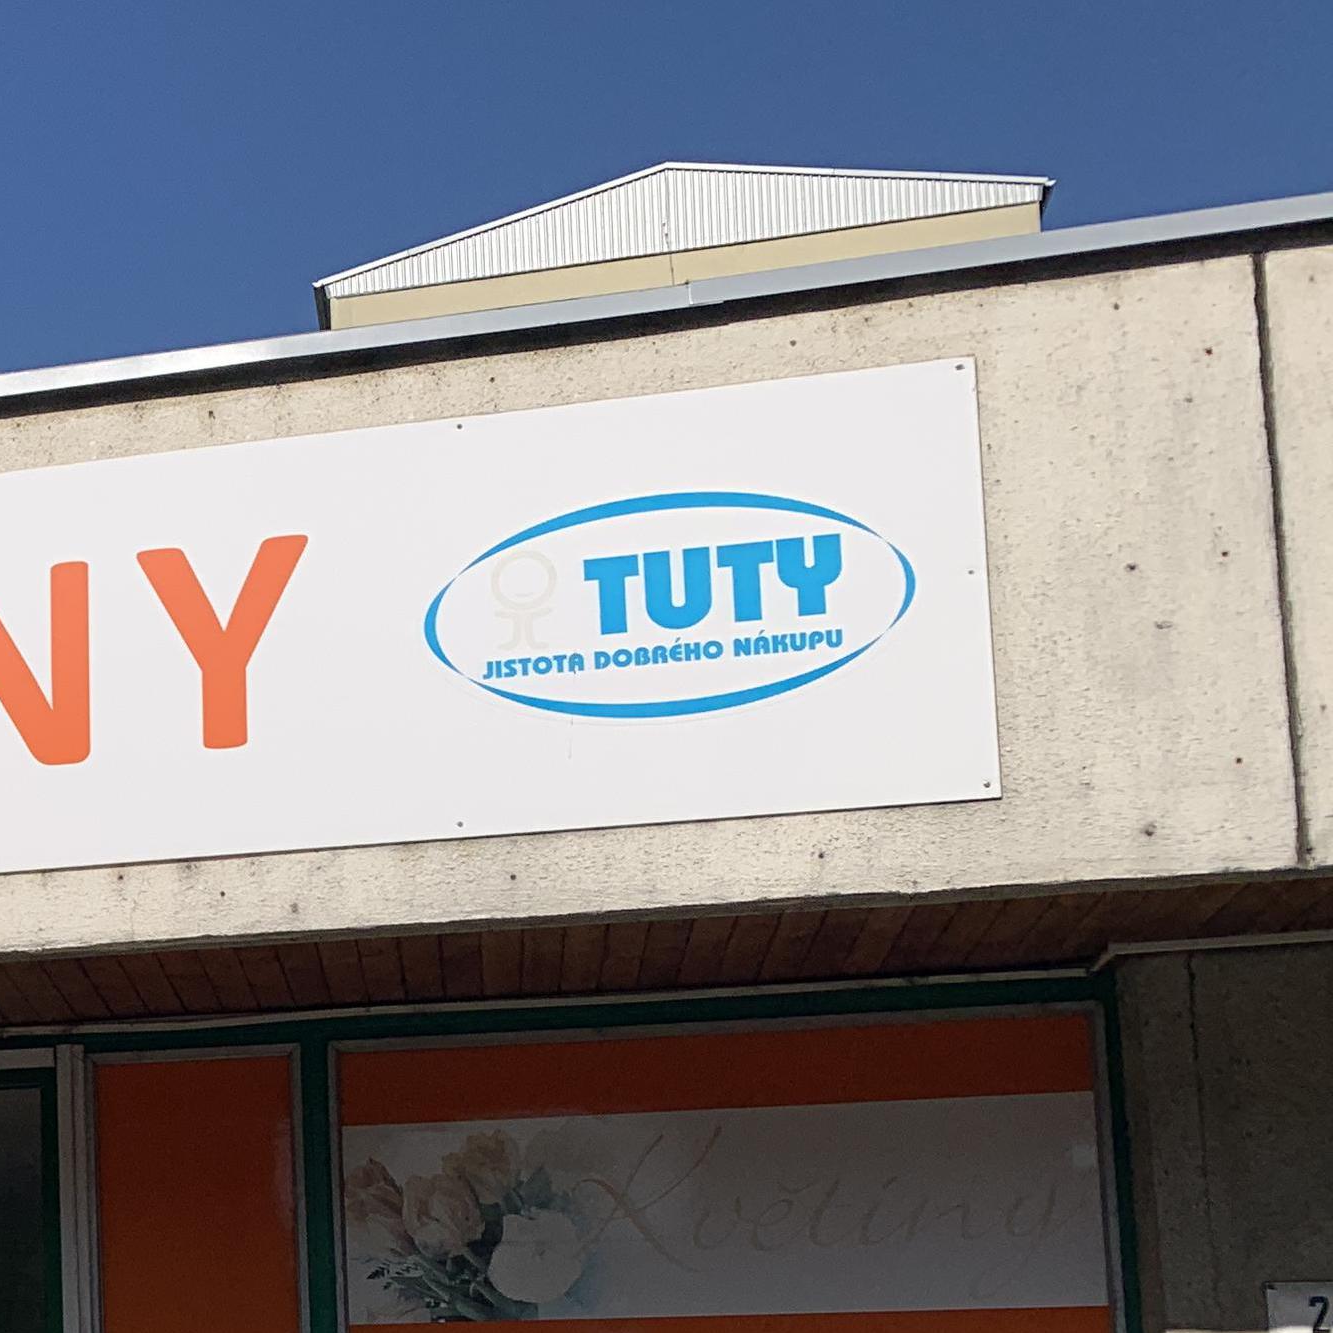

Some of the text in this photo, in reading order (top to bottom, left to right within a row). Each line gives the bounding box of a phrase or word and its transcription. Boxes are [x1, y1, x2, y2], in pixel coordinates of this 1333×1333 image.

[583, 533, 842, 636] TUTY
[482, 628, 844, 681] JISTOTA DOBRÉHO NÁKUPU
